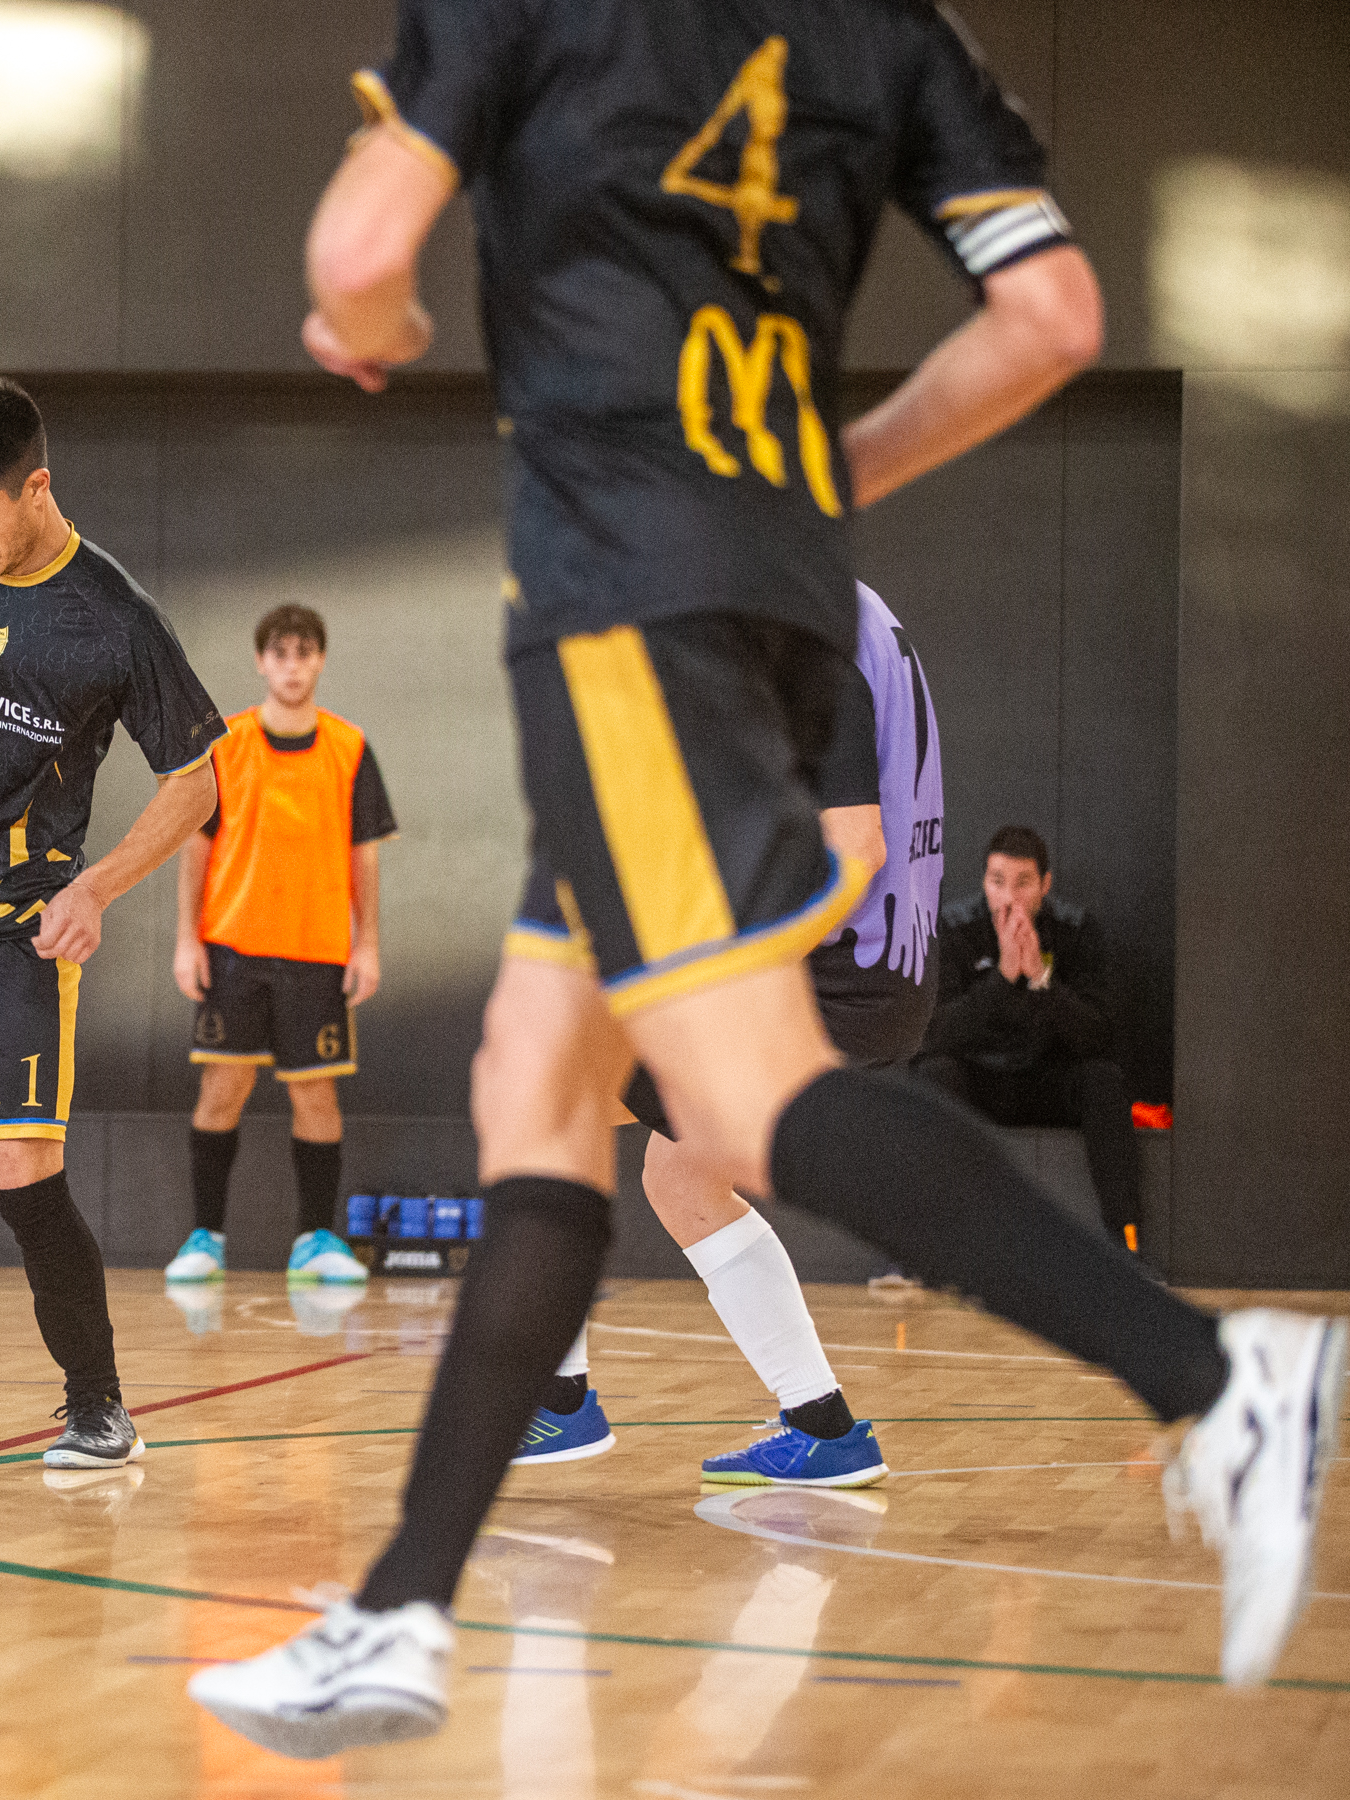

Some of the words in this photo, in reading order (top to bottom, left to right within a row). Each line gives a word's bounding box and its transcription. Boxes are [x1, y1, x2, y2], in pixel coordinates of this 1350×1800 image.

[661, 35, 799, 292] 4
[0, 720, 62, 744] INTERNAZIONALI
[32, 716, 66, 732] S.R.L.
[316, 1024, 340, 1059] 6
